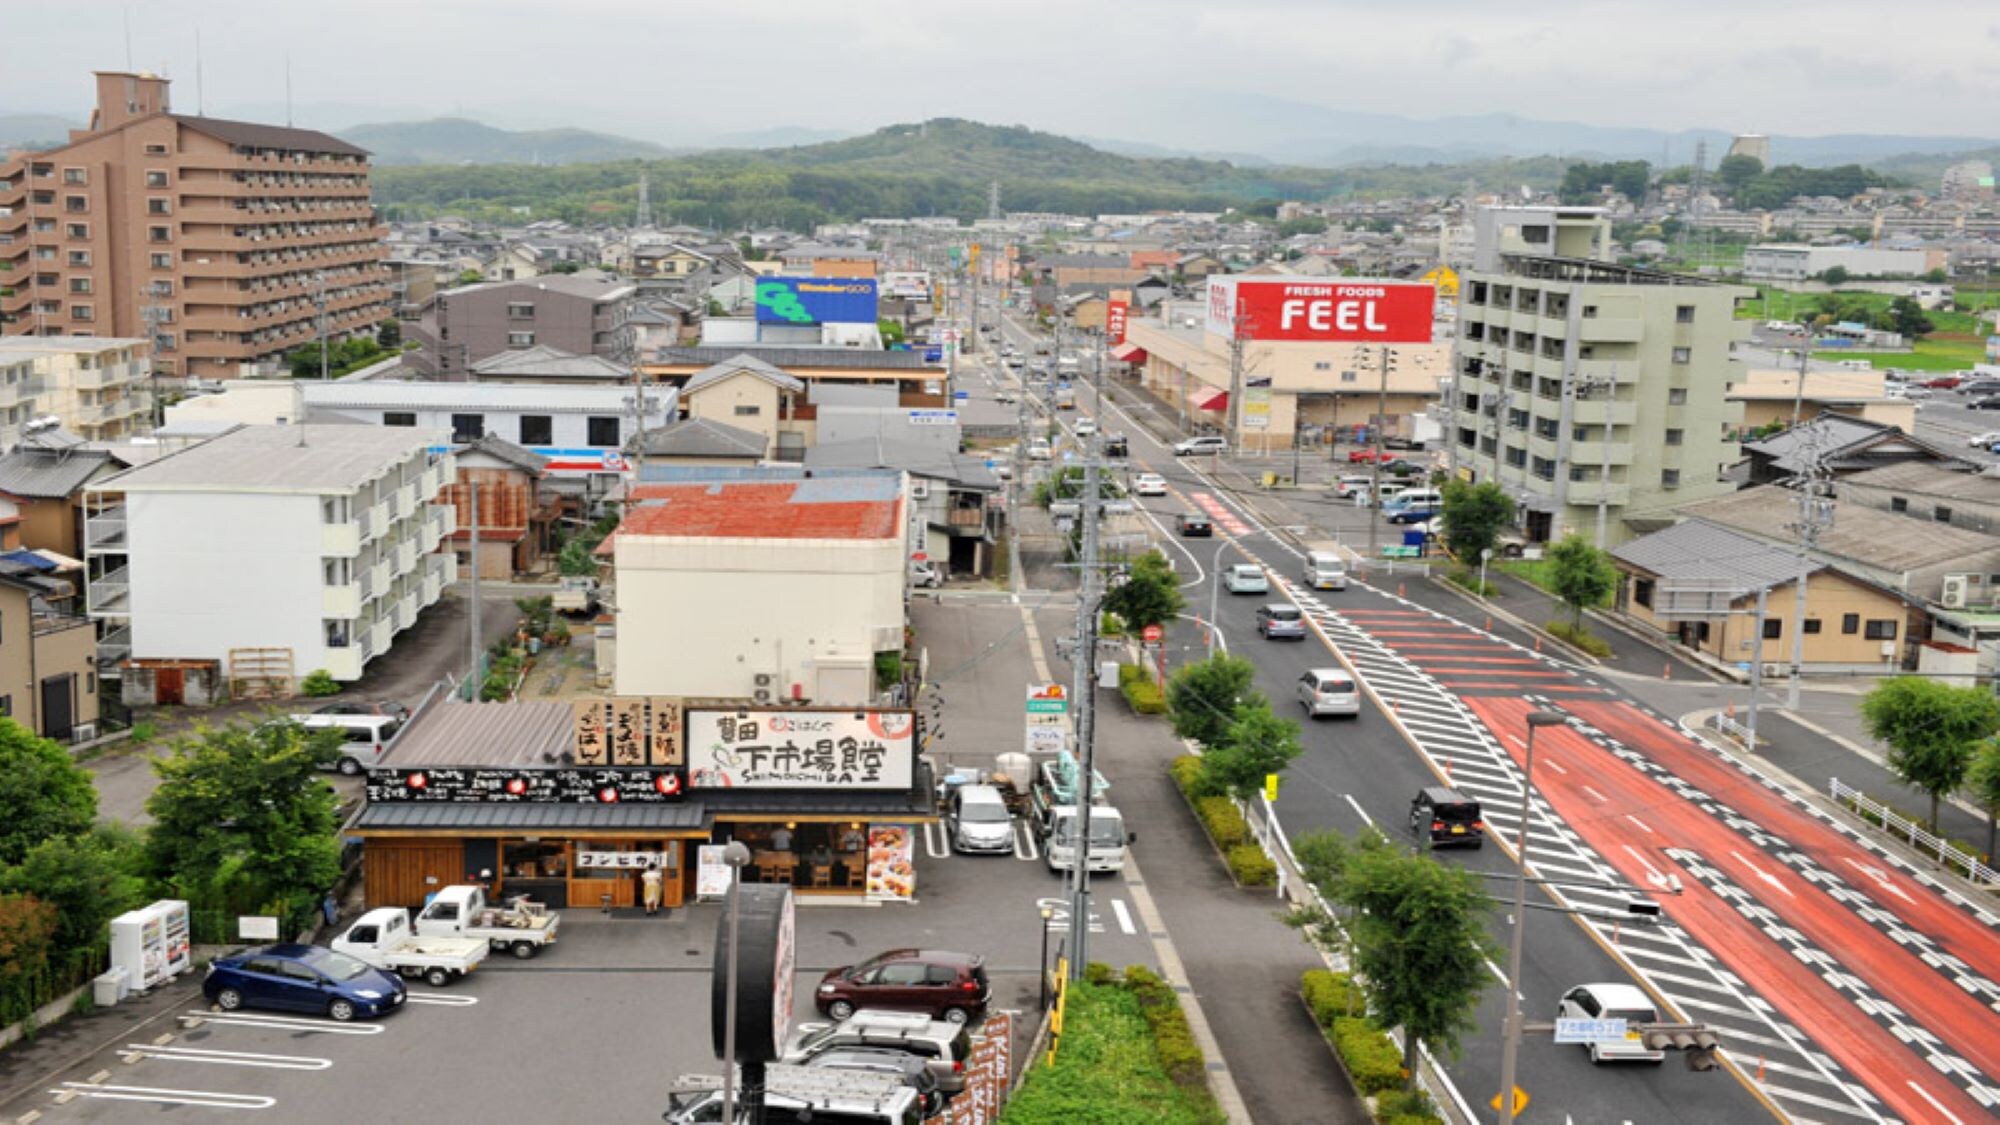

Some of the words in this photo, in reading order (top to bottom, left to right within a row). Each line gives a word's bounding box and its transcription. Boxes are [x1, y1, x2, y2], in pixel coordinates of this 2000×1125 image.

[1284, 286, 1332, 297] FRESH
[1337, 286, 1386, 298] FOODS
[1280, 299, 1388, 332] FEEL
[735, 735, 887, 782] 下市場食堂
